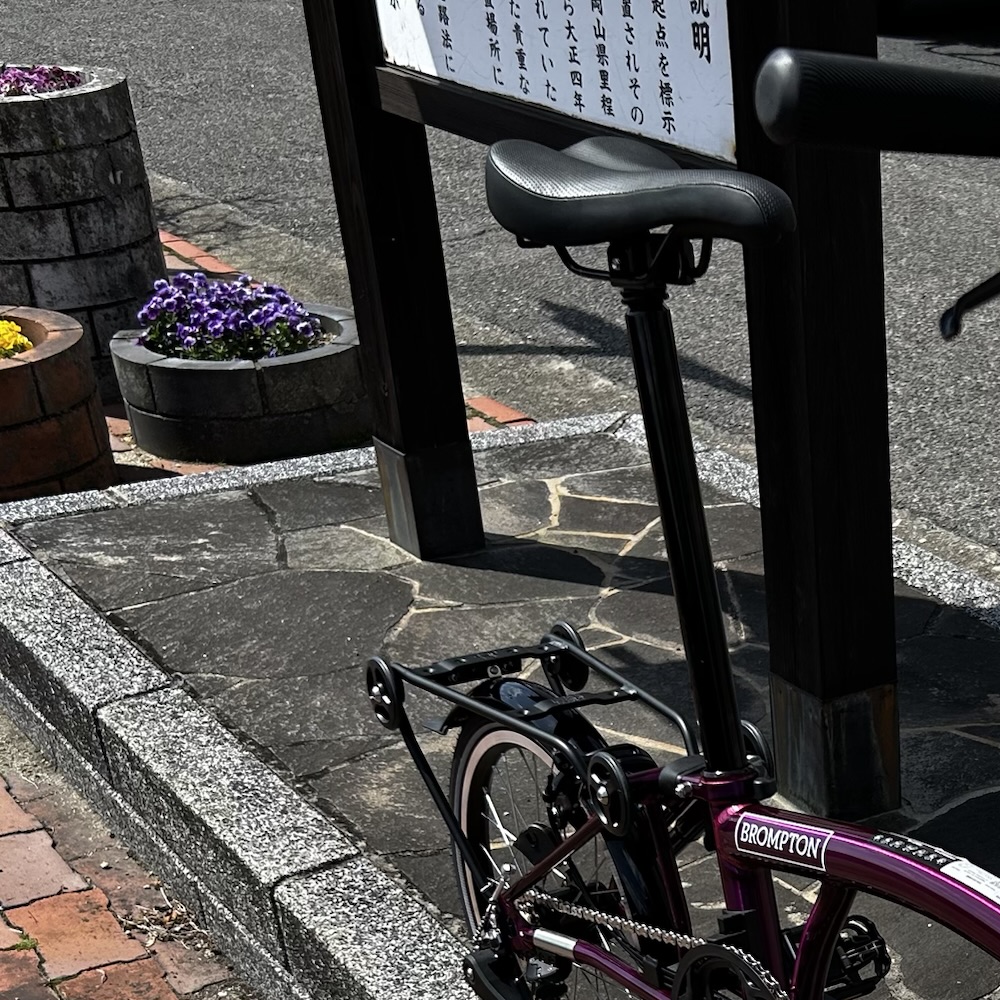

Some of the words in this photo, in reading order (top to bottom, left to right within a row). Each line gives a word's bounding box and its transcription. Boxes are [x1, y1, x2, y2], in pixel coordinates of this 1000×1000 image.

[437, 0, 456, 73] 路法に
[739, 822, 822, 860] BROMPTON
